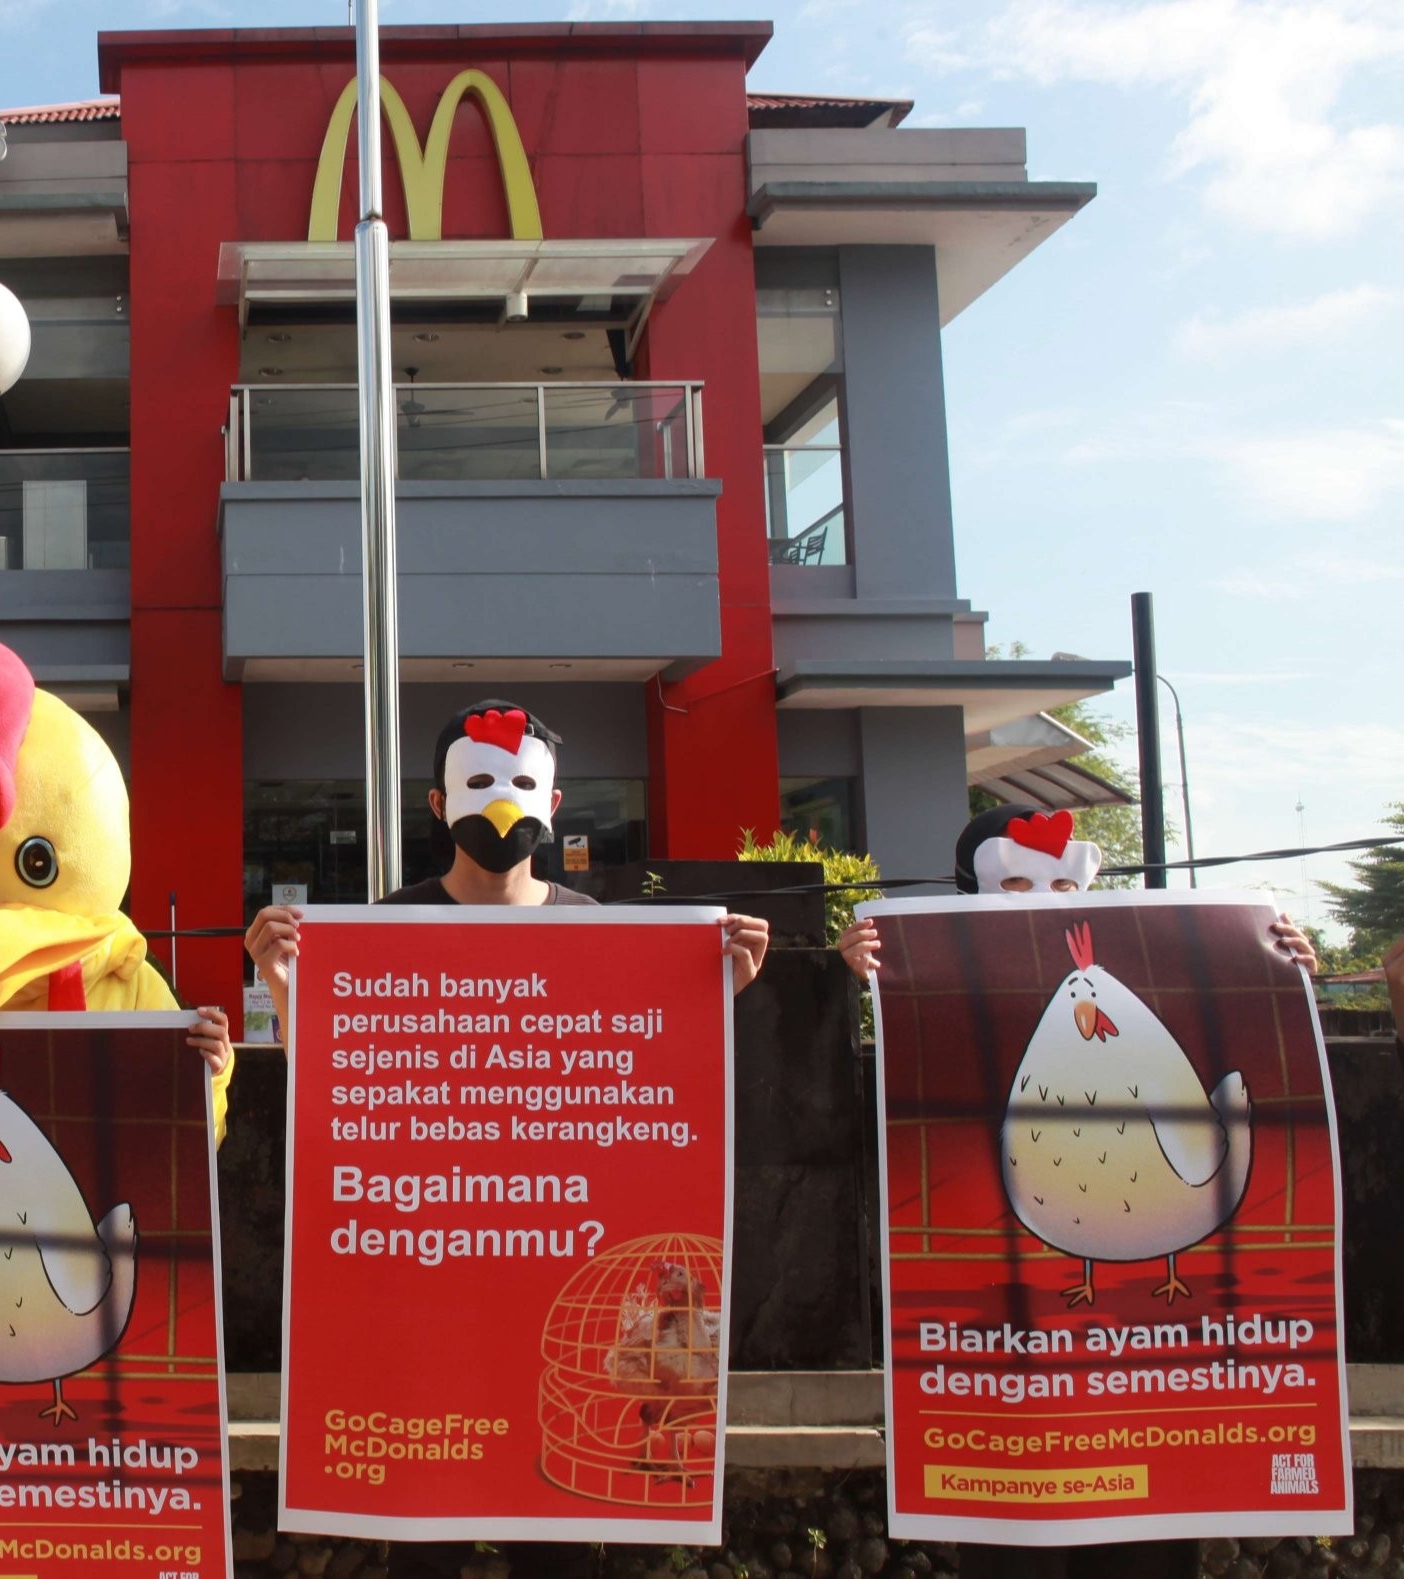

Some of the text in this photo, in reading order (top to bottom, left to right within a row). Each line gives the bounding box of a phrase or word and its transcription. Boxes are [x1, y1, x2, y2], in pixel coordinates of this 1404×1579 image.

[333, 972, 547, 1003] Sudah banyak
[334, 1009, 662, 1038] perusahaan cepat saji
[332, 1045, 632, 1075] sejenis di Asia yang
[332, 1081, 673, 1110] sepakat menggunakan
[331, 1116, 697, 1147] telur bebas kerangkeng.
[334, 1166, 588, 1212] Bagaimana
[331, 1220, 604, 1265] denganmu?
[920, 1314, 1313, 1356] Biarkan ayam hidup
[920, 1359, 1315, 1403] dengan semestinya.
[325, 1410, 508, 1439] GoCageFree
[924, 1423, 1315, 1455] GoCageFreeMcDonalds.org
[89, 1438, 198, 1474] hidup
[326, 1434, 483, 1460] McDonalds
[1272, 1454, 1314, 1468] ACT FOR
[942, 1474, 1134, 1497] Kampanye se-Asia
[1271, 1479, 1318, 1494] ANIMALS
[1272, 1467, 1316, 1481] FARMED
